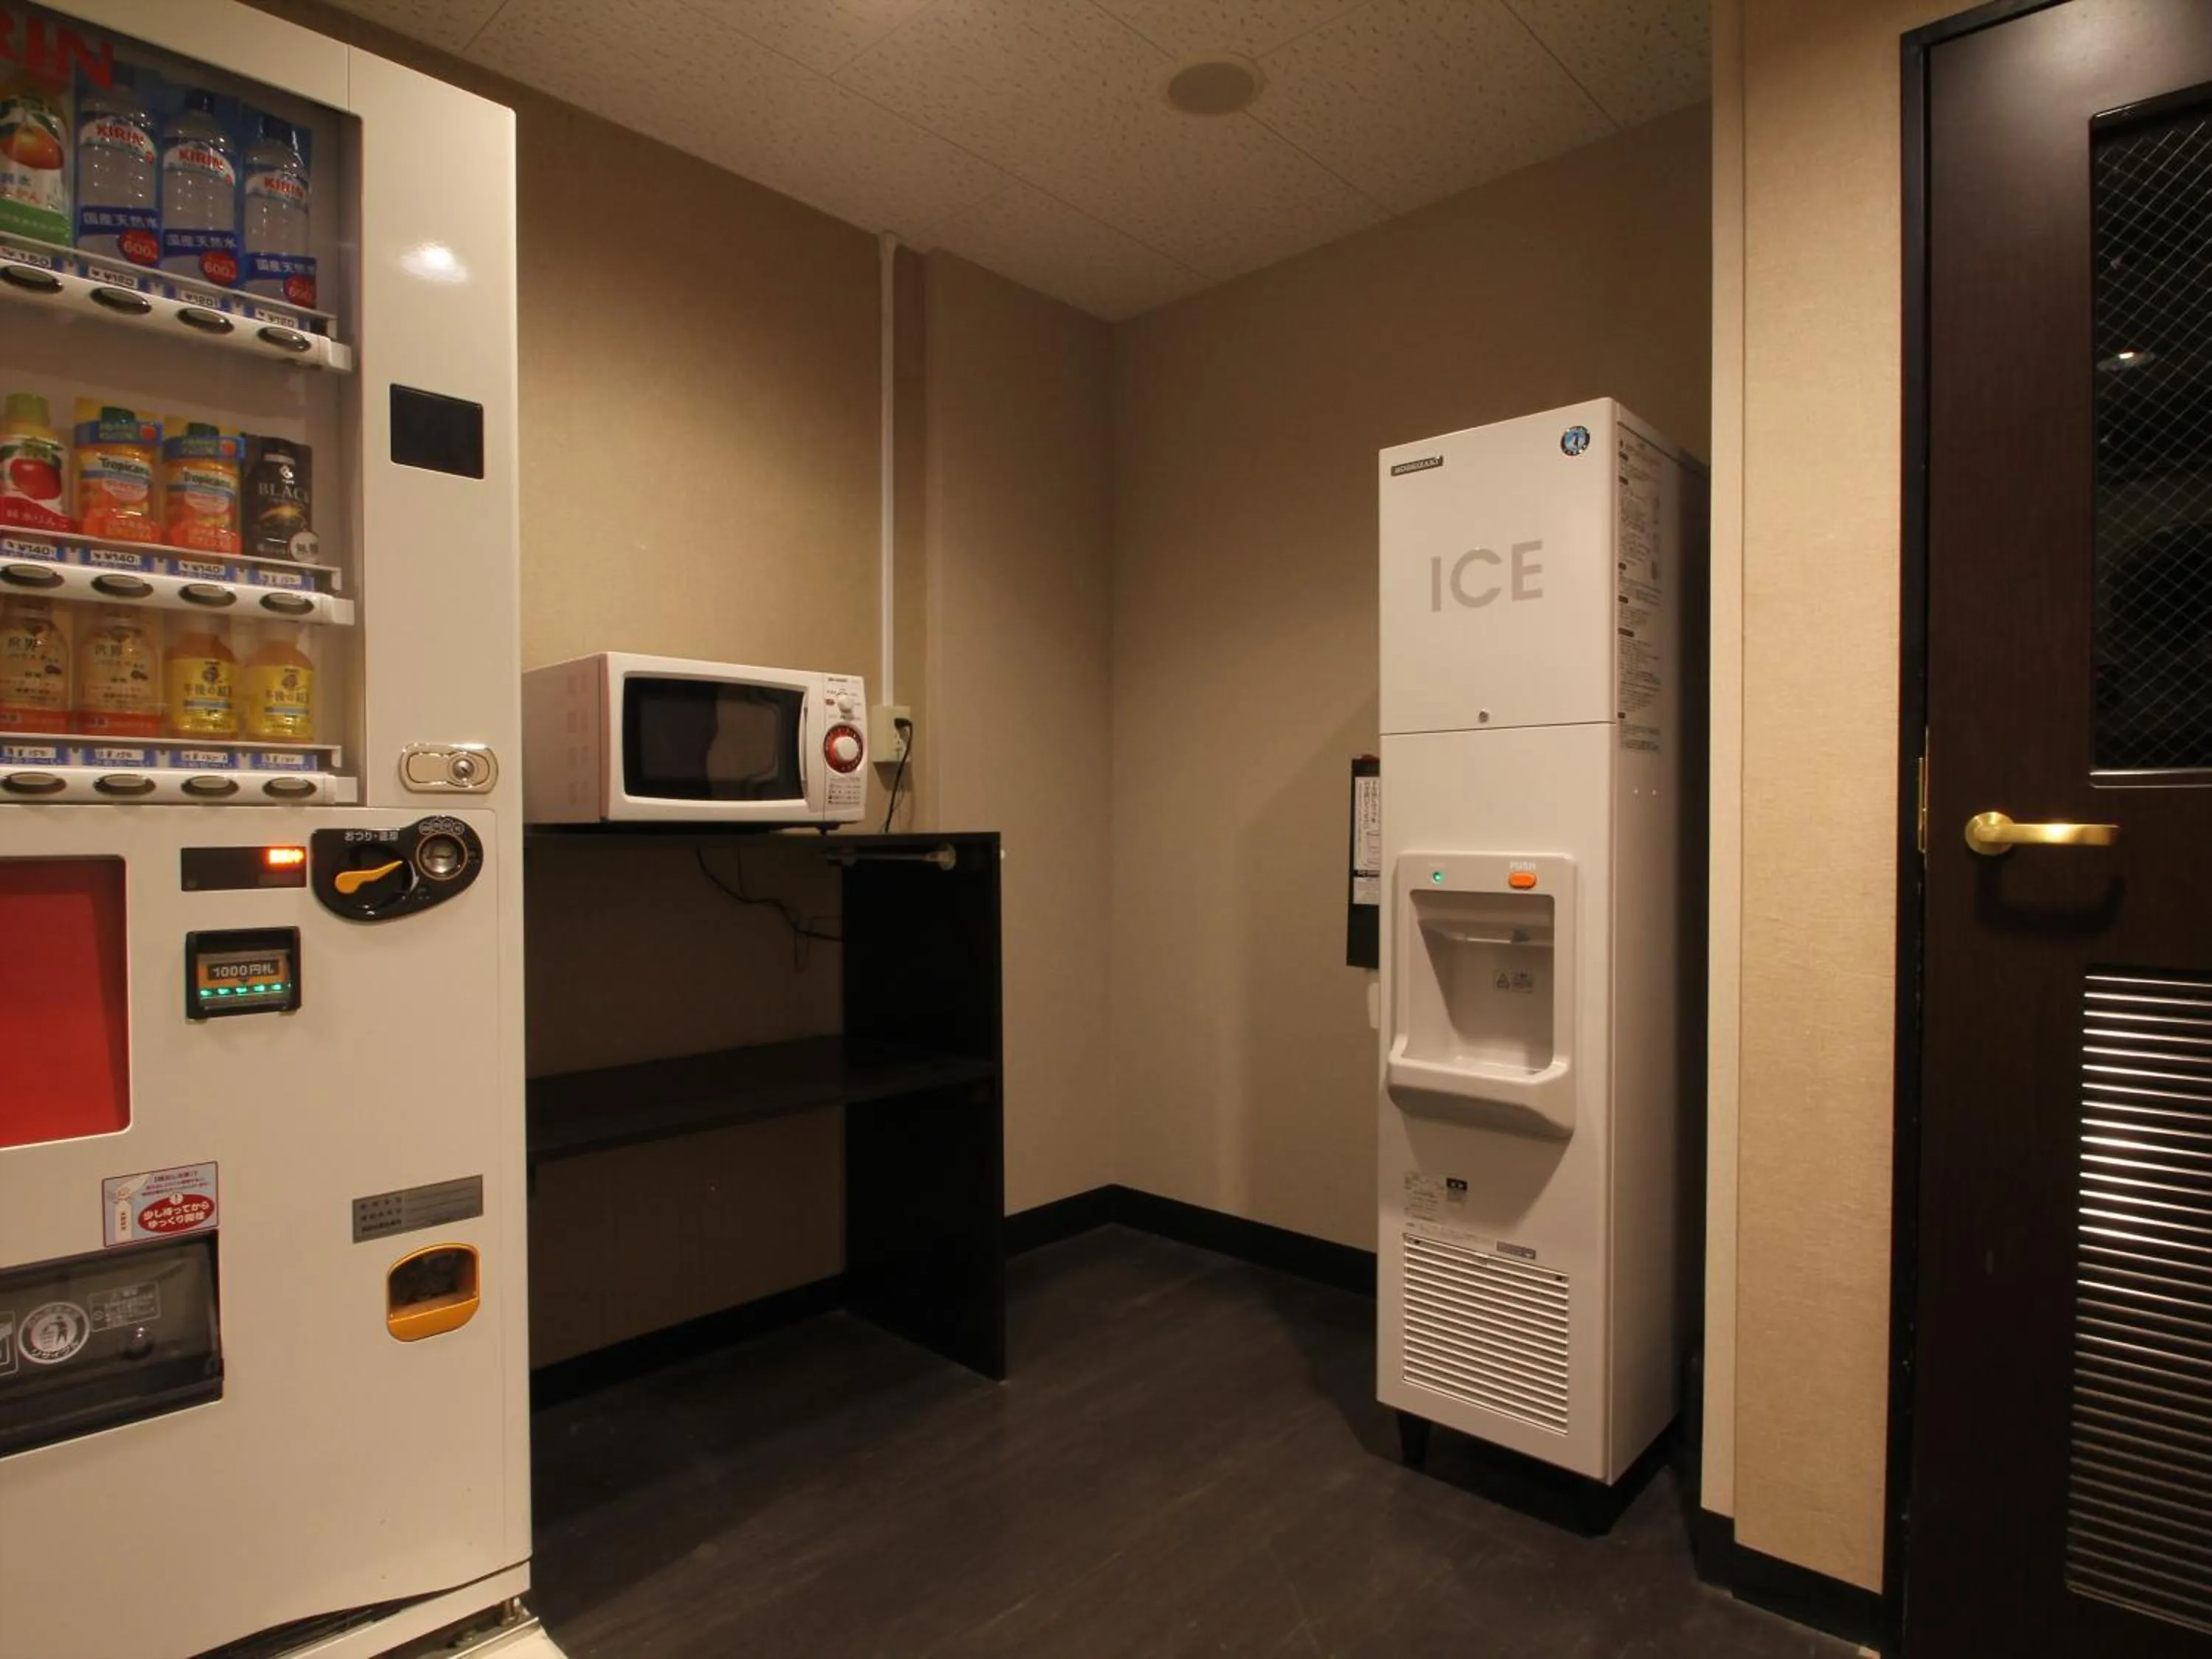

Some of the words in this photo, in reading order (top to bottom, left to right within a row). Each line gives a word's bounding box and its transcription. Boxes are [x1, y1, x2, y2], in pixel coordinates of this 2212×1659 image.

[96, 125, 145, 147] KIRIN
[178, 150, 224, 170] KIRIN
[264, 176, 303, 198] KIRIN
[1431, 540, 1543, 612] ICE
[1509, 860, 1536, 870] PUSH
[212, 961, 275, 978] 1000円札
